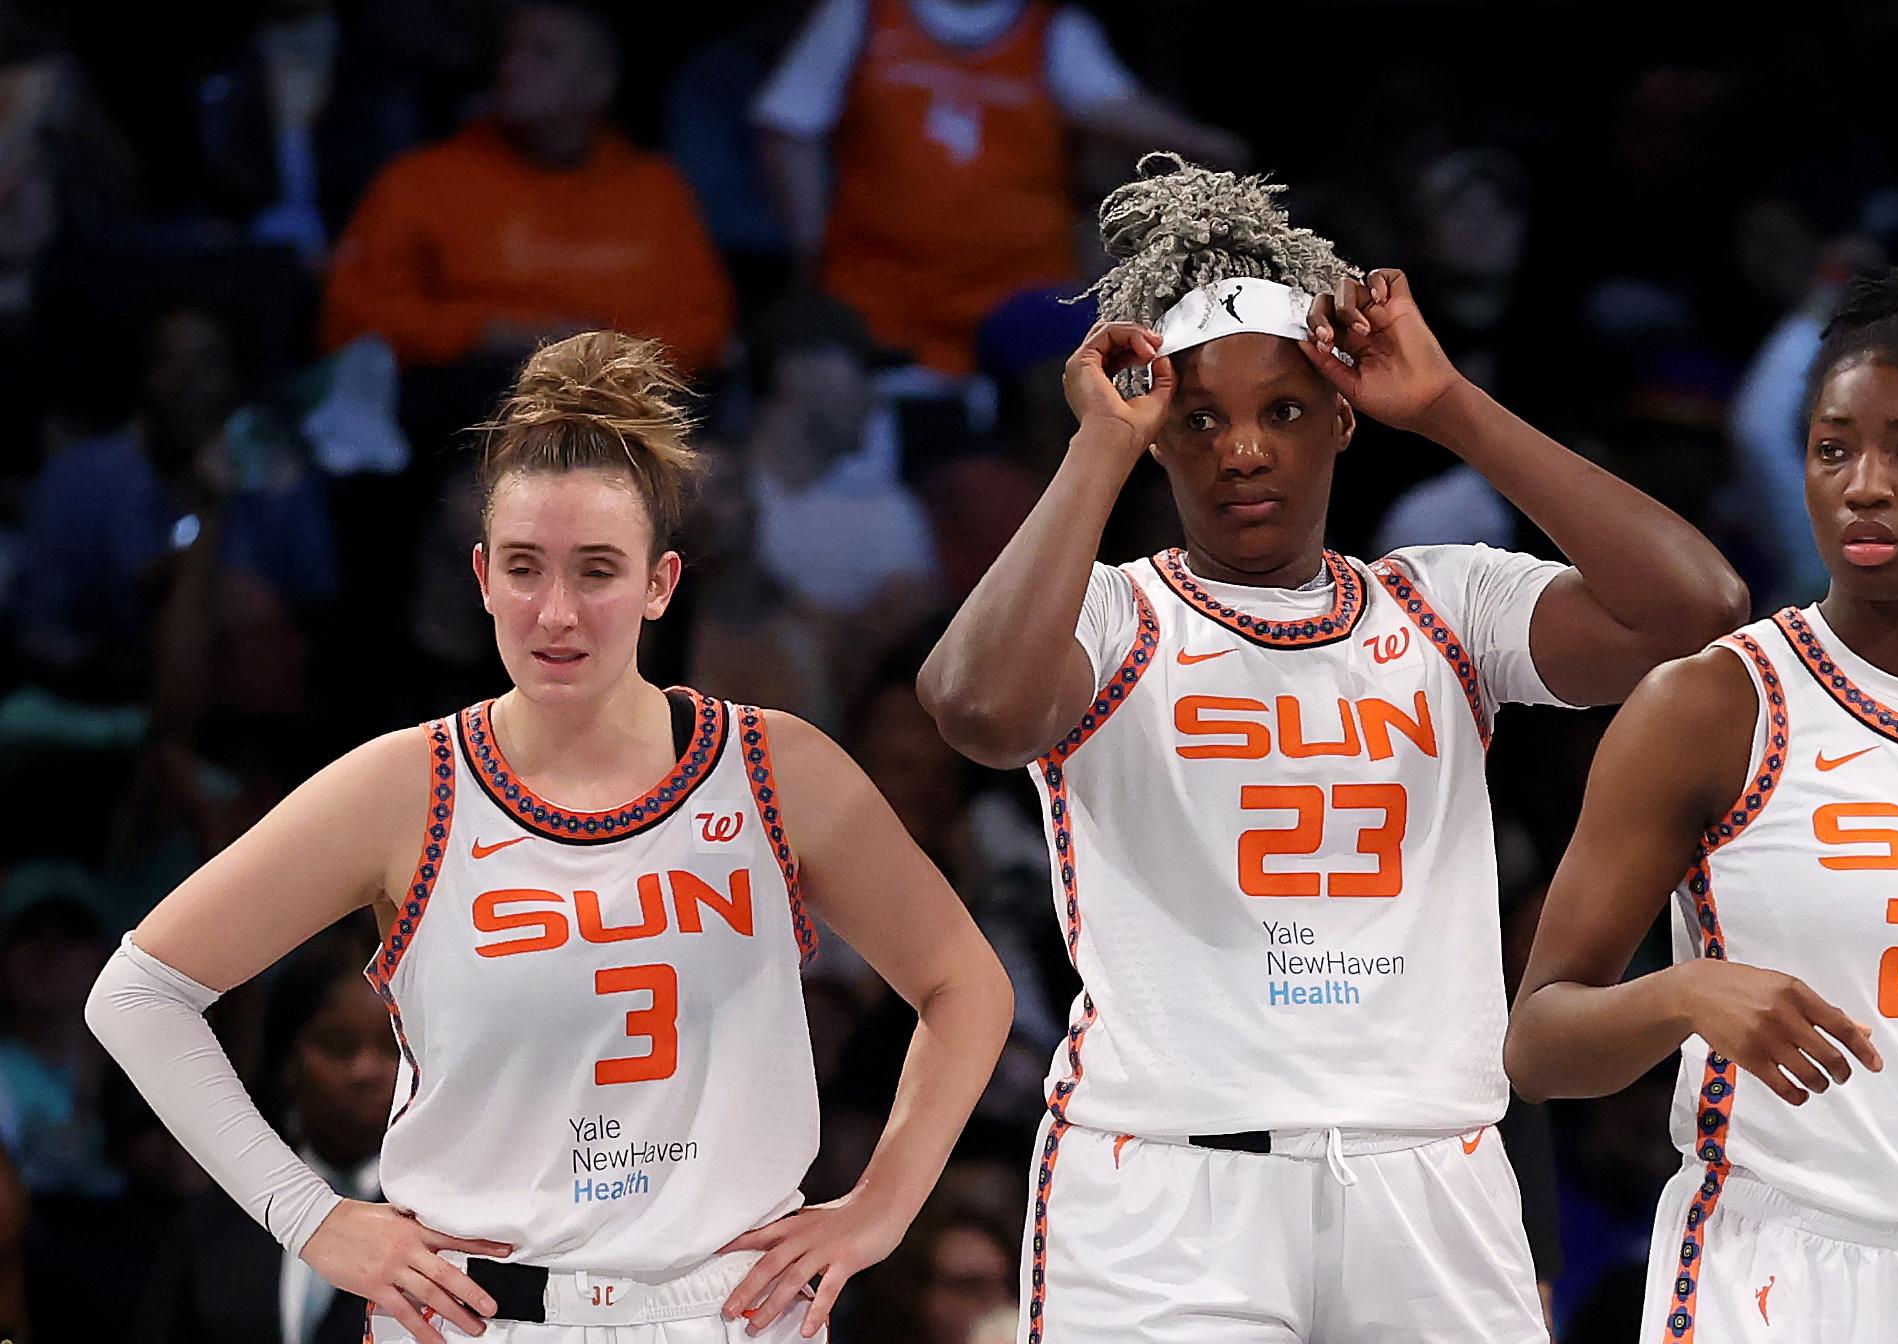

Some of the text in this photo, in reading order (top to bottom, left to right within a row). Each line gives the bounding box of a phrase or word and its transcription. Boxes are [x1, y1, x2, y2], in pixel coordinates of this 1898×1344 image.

[1174, 691, 1437, 761] SUN
[1238, 784, 1407, 897] 23
[473, 869, 753, 958] SUN
[1263, 921, 1315, 945] Yale
[1267, 950, 1404, 975] NewHaven
[1270, 981, 1359, 1005] Health
[595, 964, 677, 1085] 3
[569, 1115, 621, 1141] Yale
[573, 1139, 698, 1173] NewHaven
[576, 1173, 648, 1201] Health
